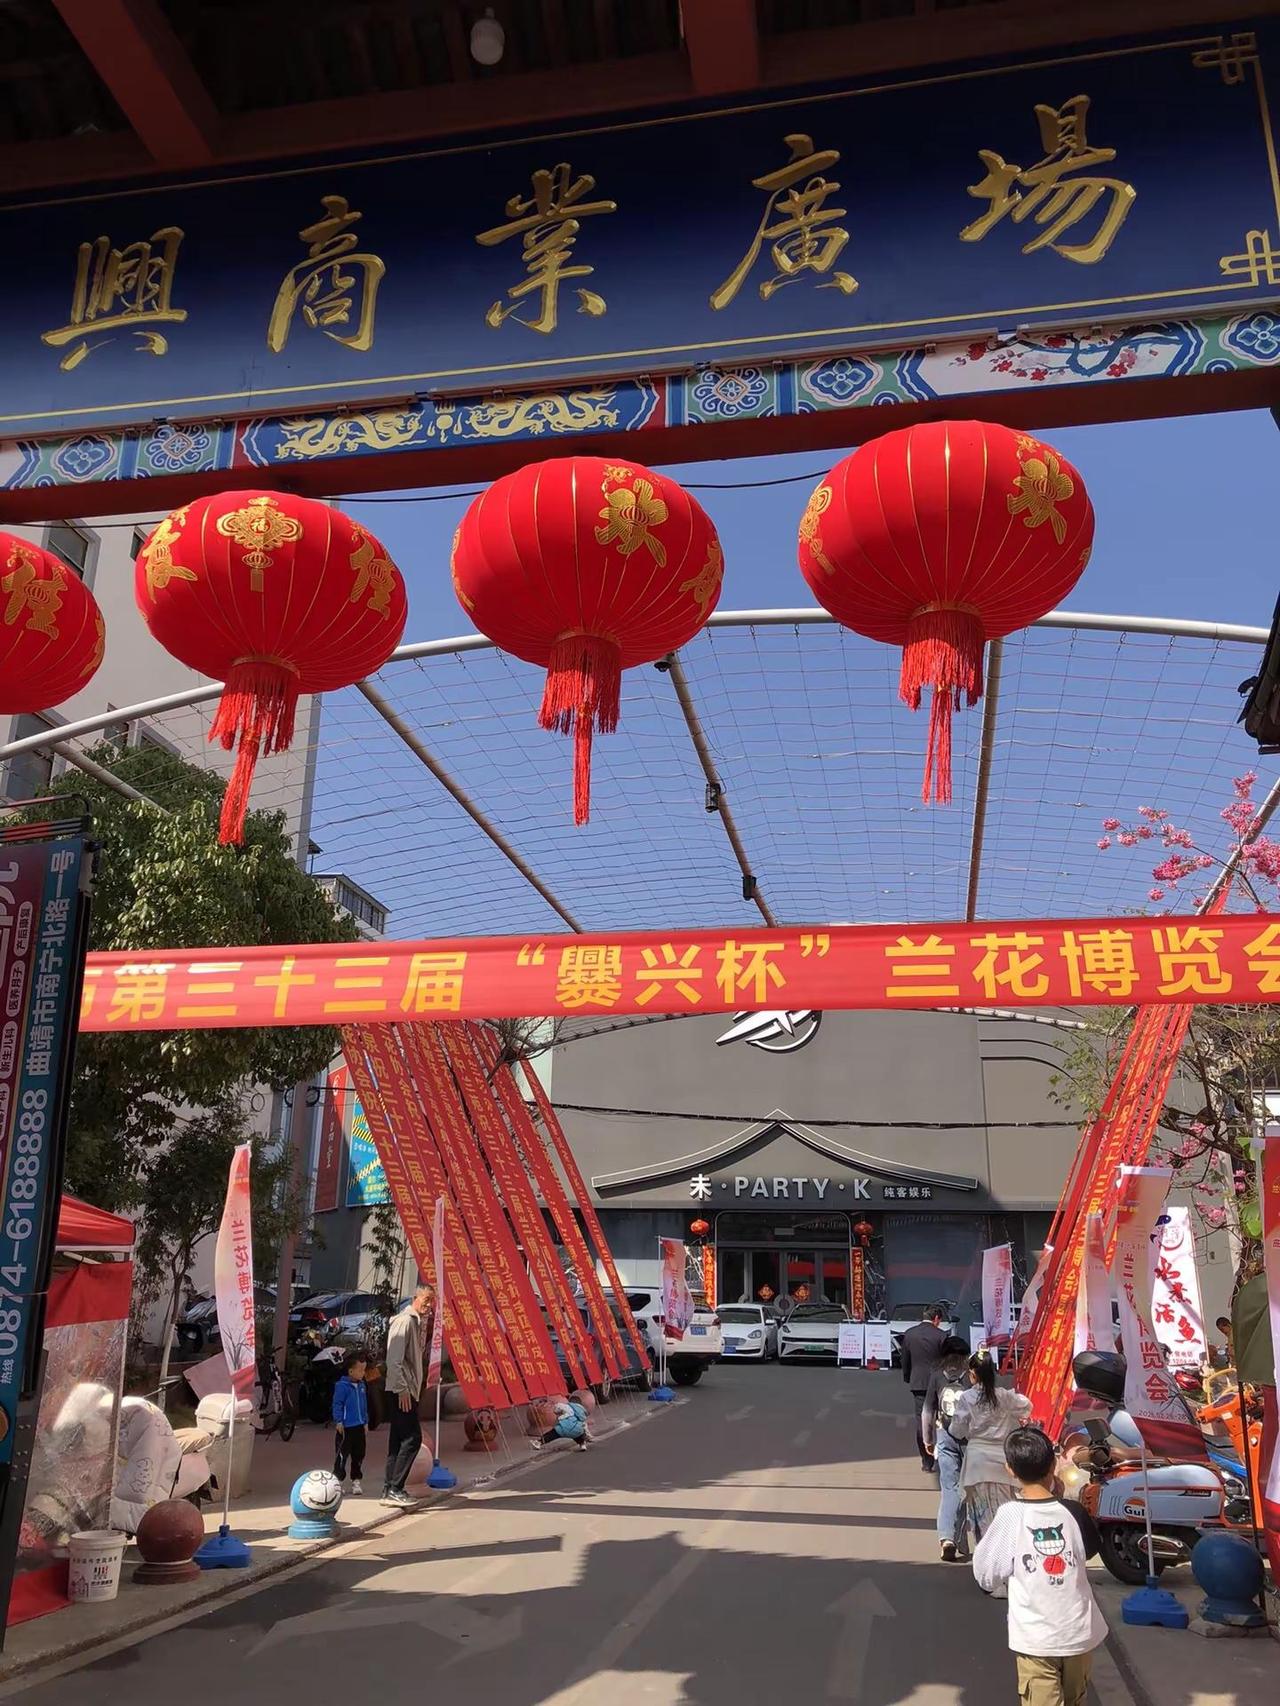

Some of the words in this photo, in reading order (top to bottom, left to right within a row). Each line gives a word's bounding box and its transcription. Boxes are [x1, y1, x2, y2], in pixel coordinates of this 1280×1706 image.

[40, 94, 1137, 372] 興商業廣場
[16, 907, 31, 950] 产后康复
[26, 849, 75, 1076] 曲靖市南宁北路一号
[8, 966, 23, 1011] 医养月子
[0, 1027, 16, 1073] 新生儿科
[883, 1186, 932, 1198] 纯客娱乐
[1153, 1256, 1202, 1344] 水煮活鱼
[1124, 1505, 1147, 1517] Gul
